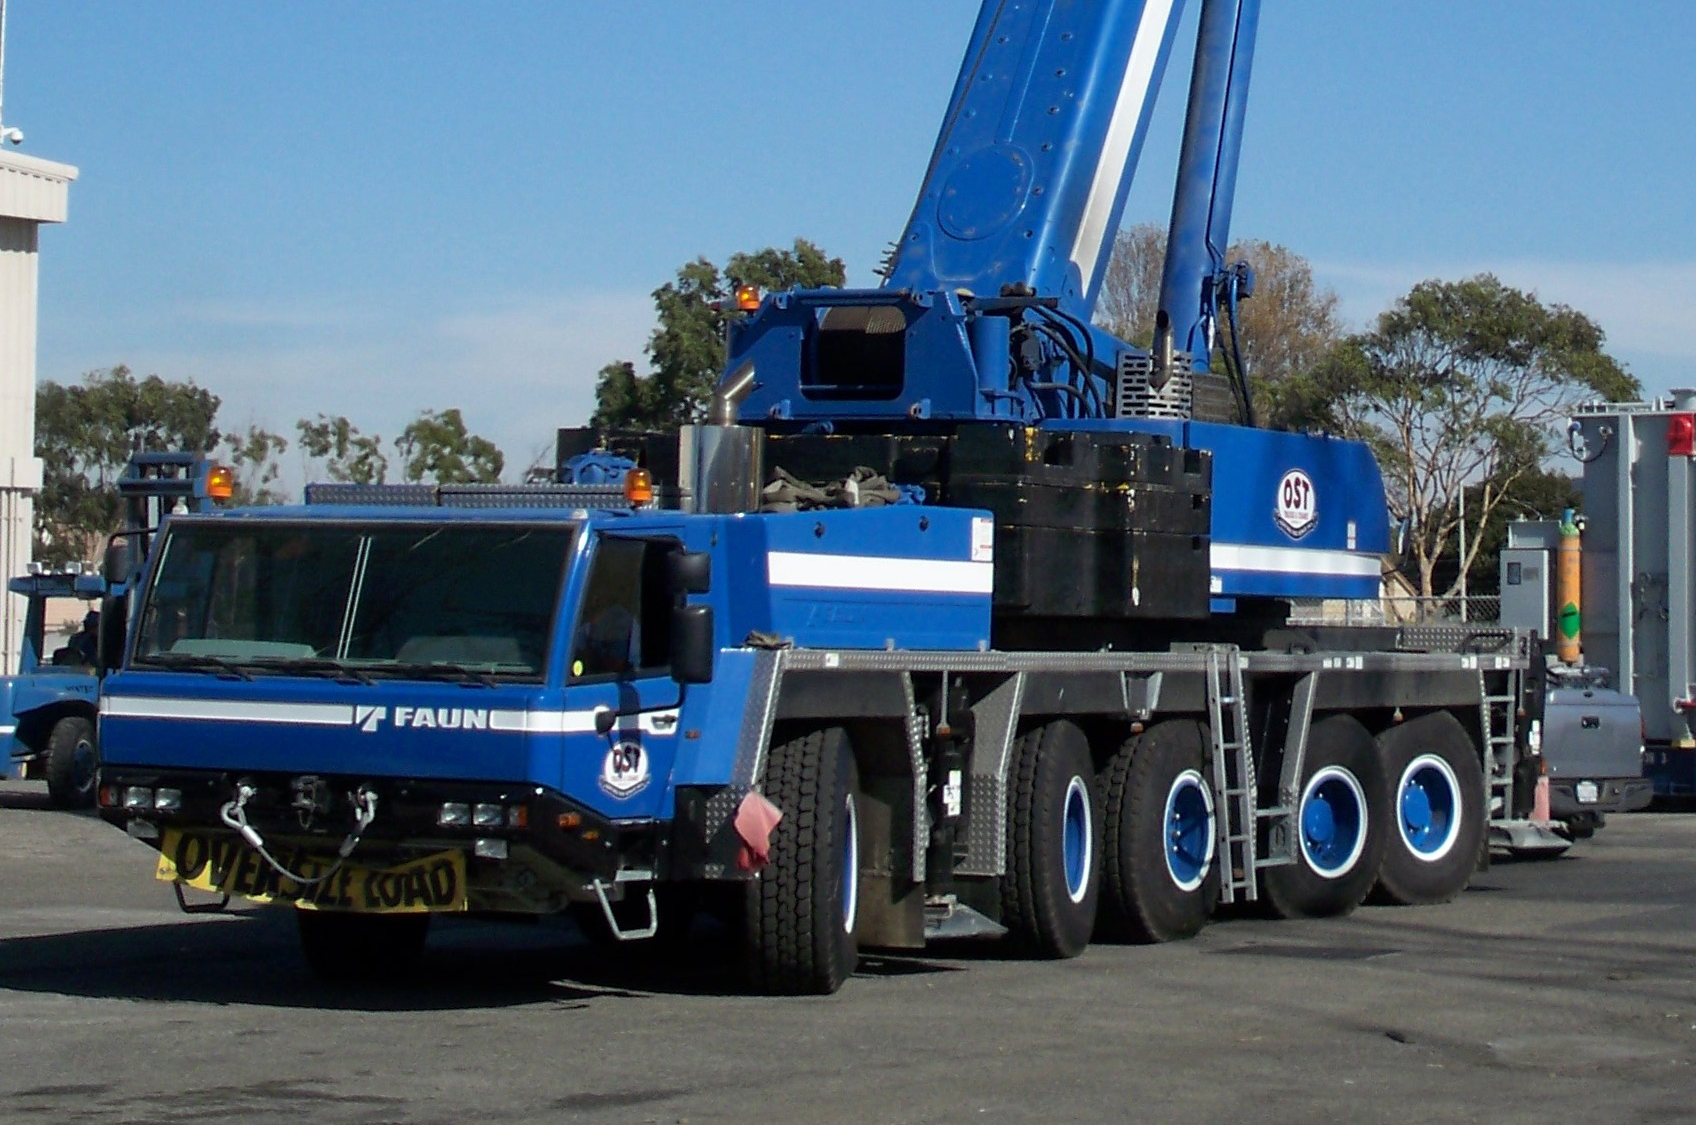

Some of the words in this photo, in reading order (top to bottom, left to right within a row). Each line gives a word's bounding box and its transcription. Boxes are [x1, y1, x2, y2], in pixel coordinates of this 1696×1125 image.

[1284, 477, 1310, 510] OST
[395, 706, 488, 729] FAUN
[174, 832, 353, 907] OVERSIZE
[364, 859, 457, 908] LOAD
